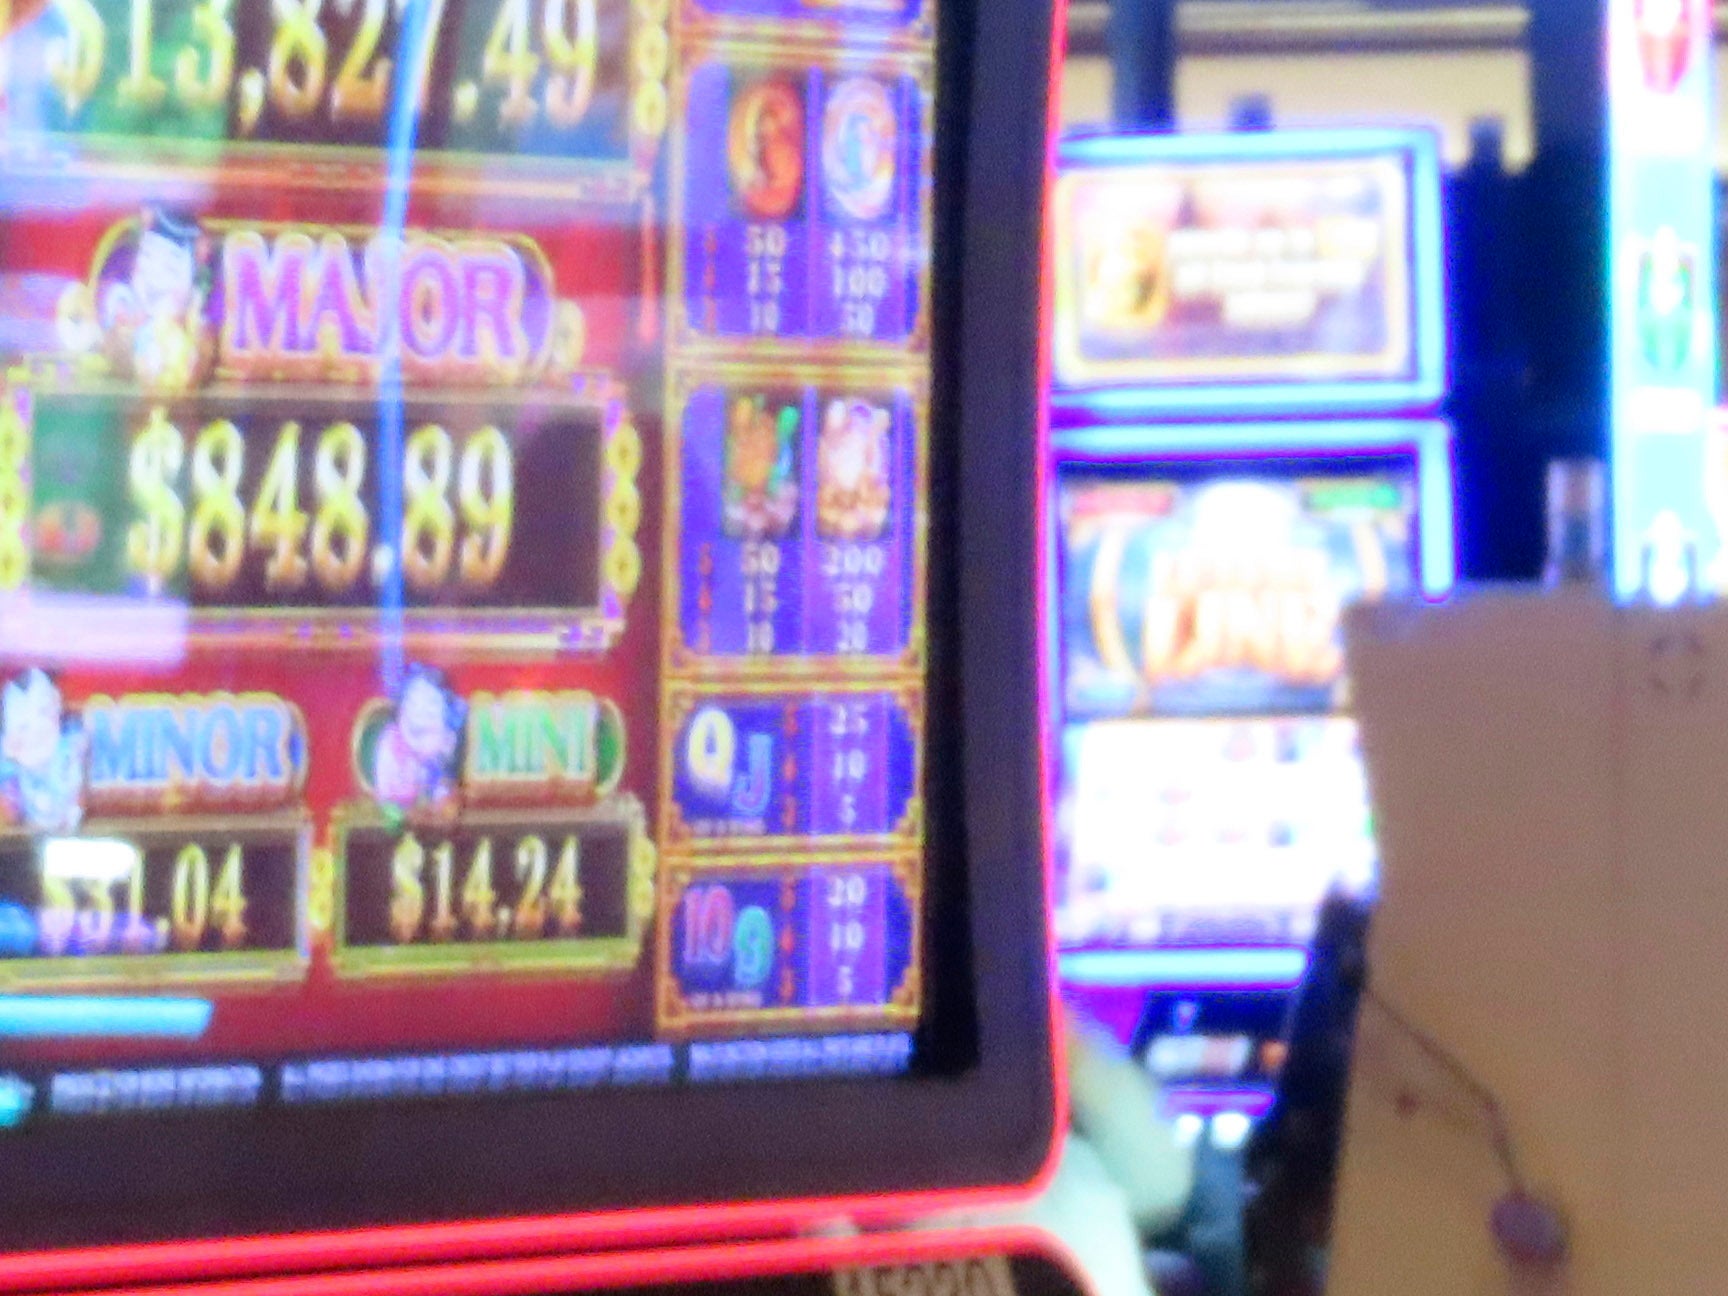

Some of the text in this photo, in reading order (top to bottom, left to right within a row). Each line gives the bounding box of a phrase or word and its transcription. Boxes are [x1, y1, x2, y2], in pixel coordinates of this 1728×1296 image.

[225, 234, 524, 360] MAJOR
[127, 408, 513, 594] $848.89
[86, 700, 290, 786] MINOR
[472, 700, 598, 782] MINI
[688, 706, 735, 793] Q
[389, 832, 583, 942] $14.24
